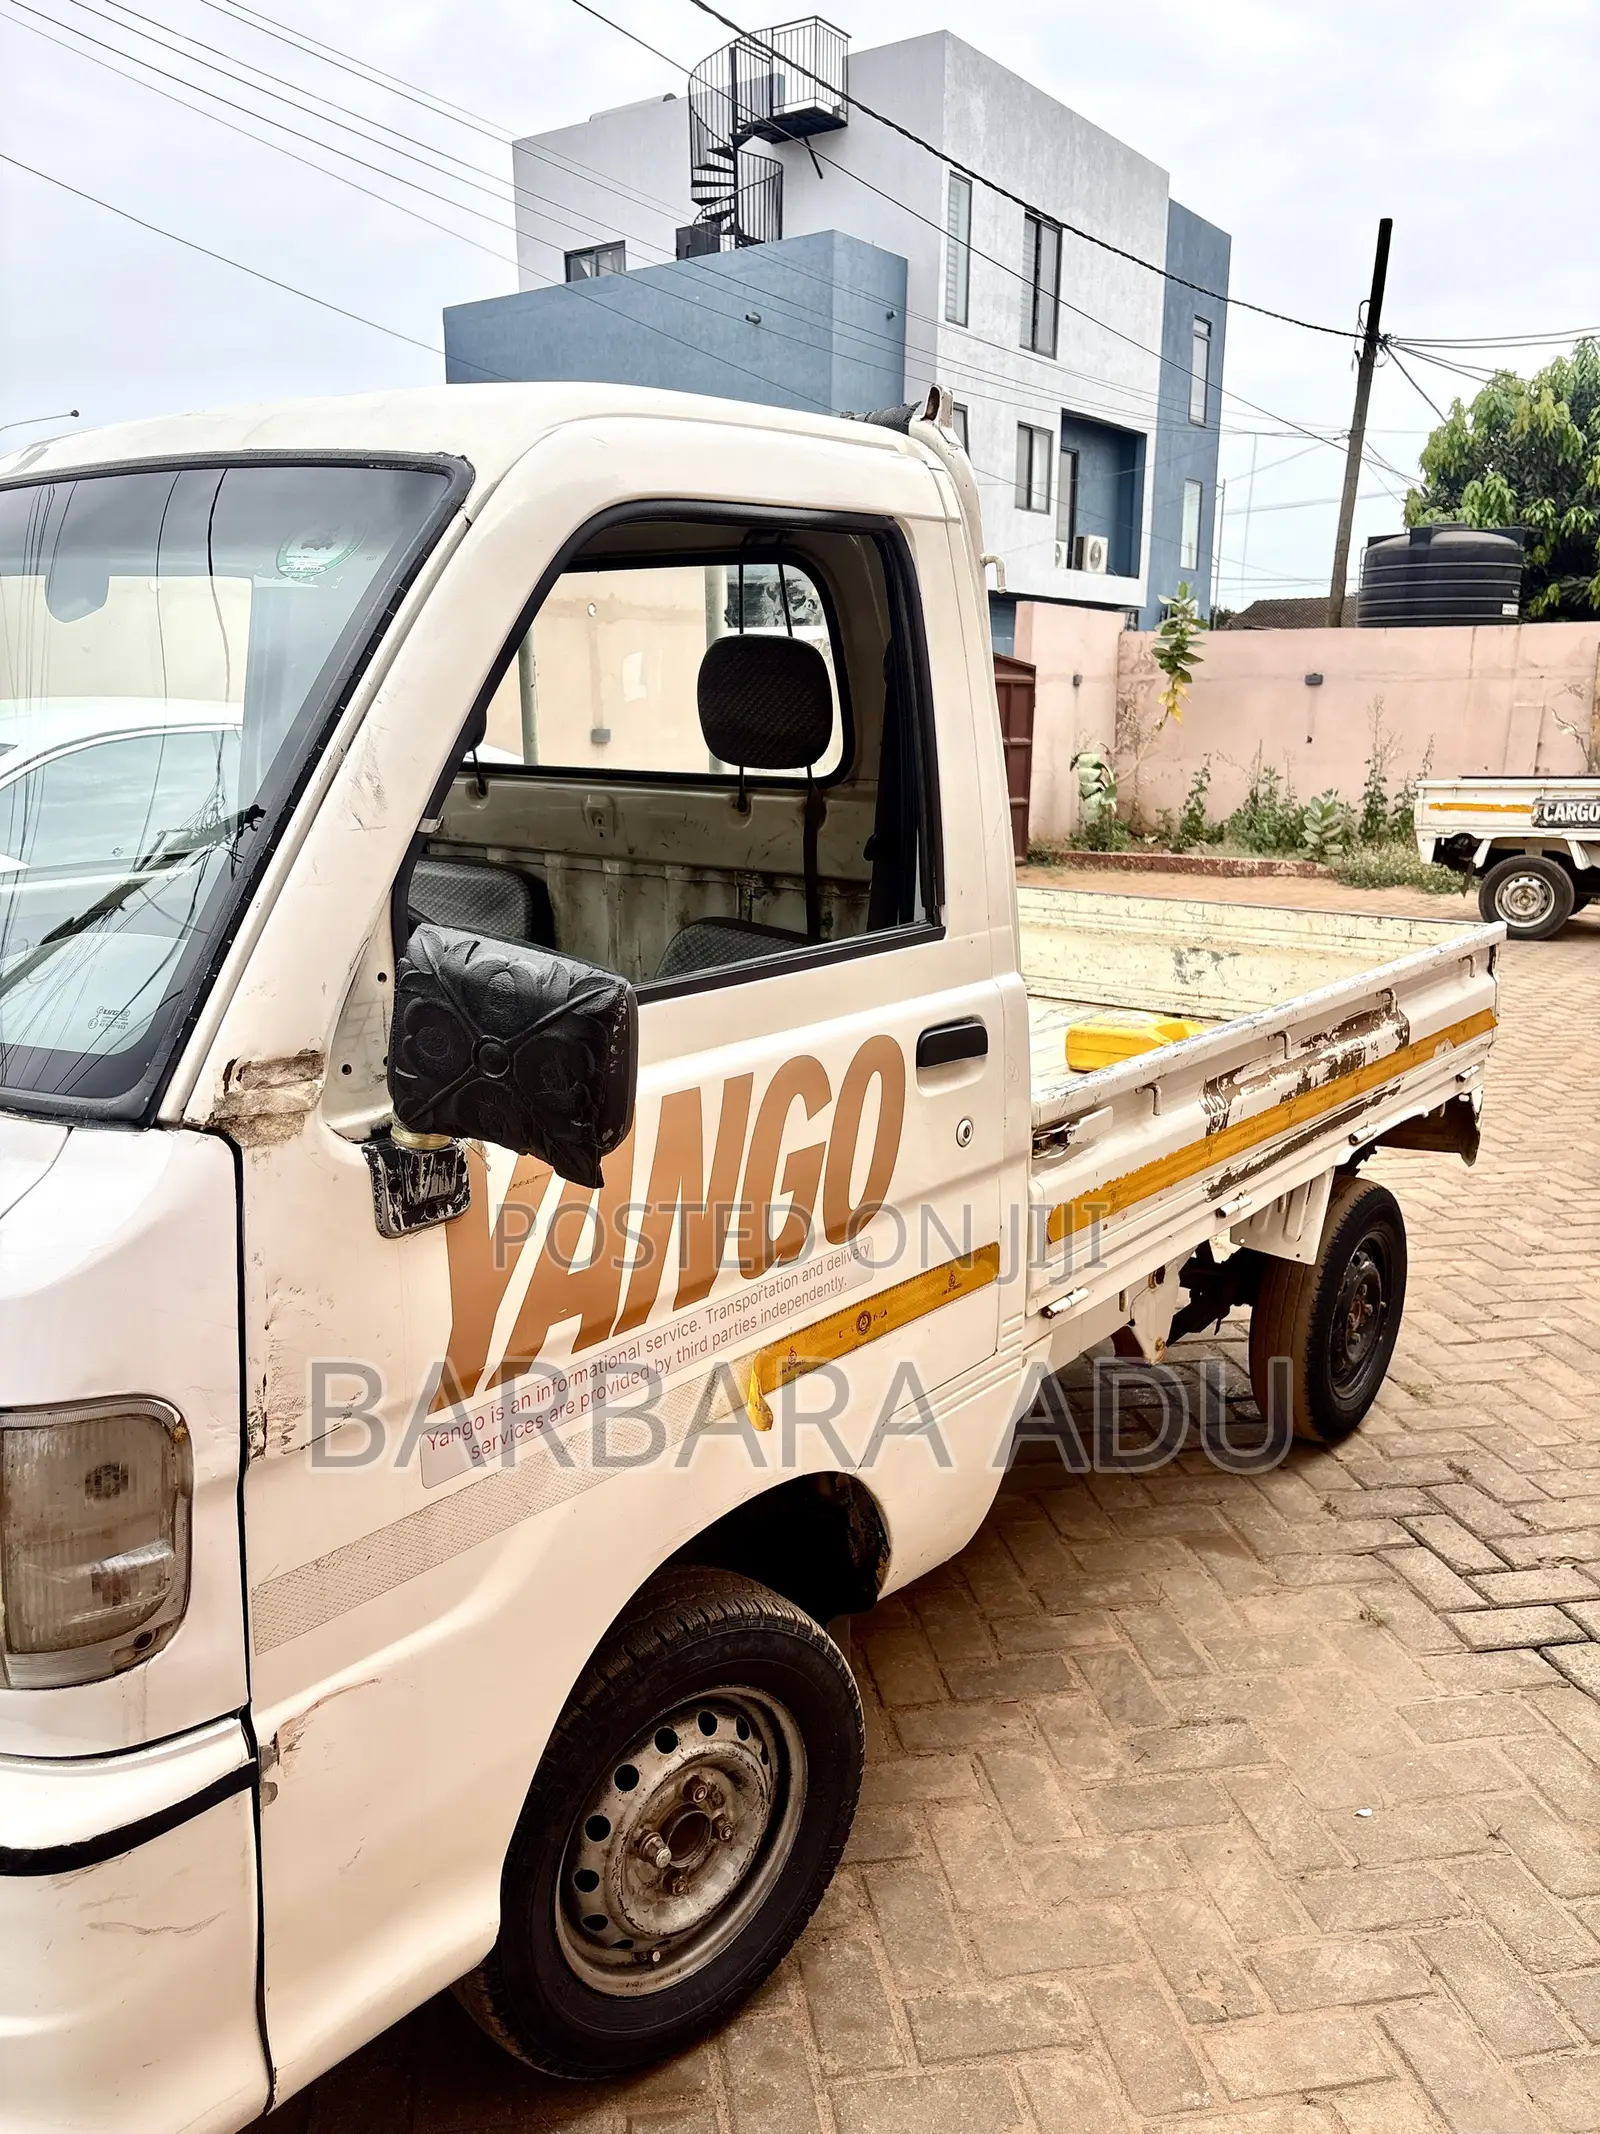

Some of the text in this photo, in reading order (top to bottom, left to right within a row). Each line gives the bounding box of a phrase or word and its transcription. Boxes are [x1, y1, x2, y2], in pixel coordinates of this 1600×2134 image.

[1543, 801, 1600, 822] CARGO
[427, 1034, 906, 1416] YANGO
[427, 1242, 870, 1451] Yango is an informational service. Transportation and delivery
[471, 1415, 544, 1460] services
[549, 1400, 575, 1422] are
[580, 1363, 650, 1412] provided
[654, 1355, 672, 1375] by
[676, 1335, 708, 1364] third
[712, 1316, 757, 1351] parties
[760, 1276, 847, 1324] independently.
